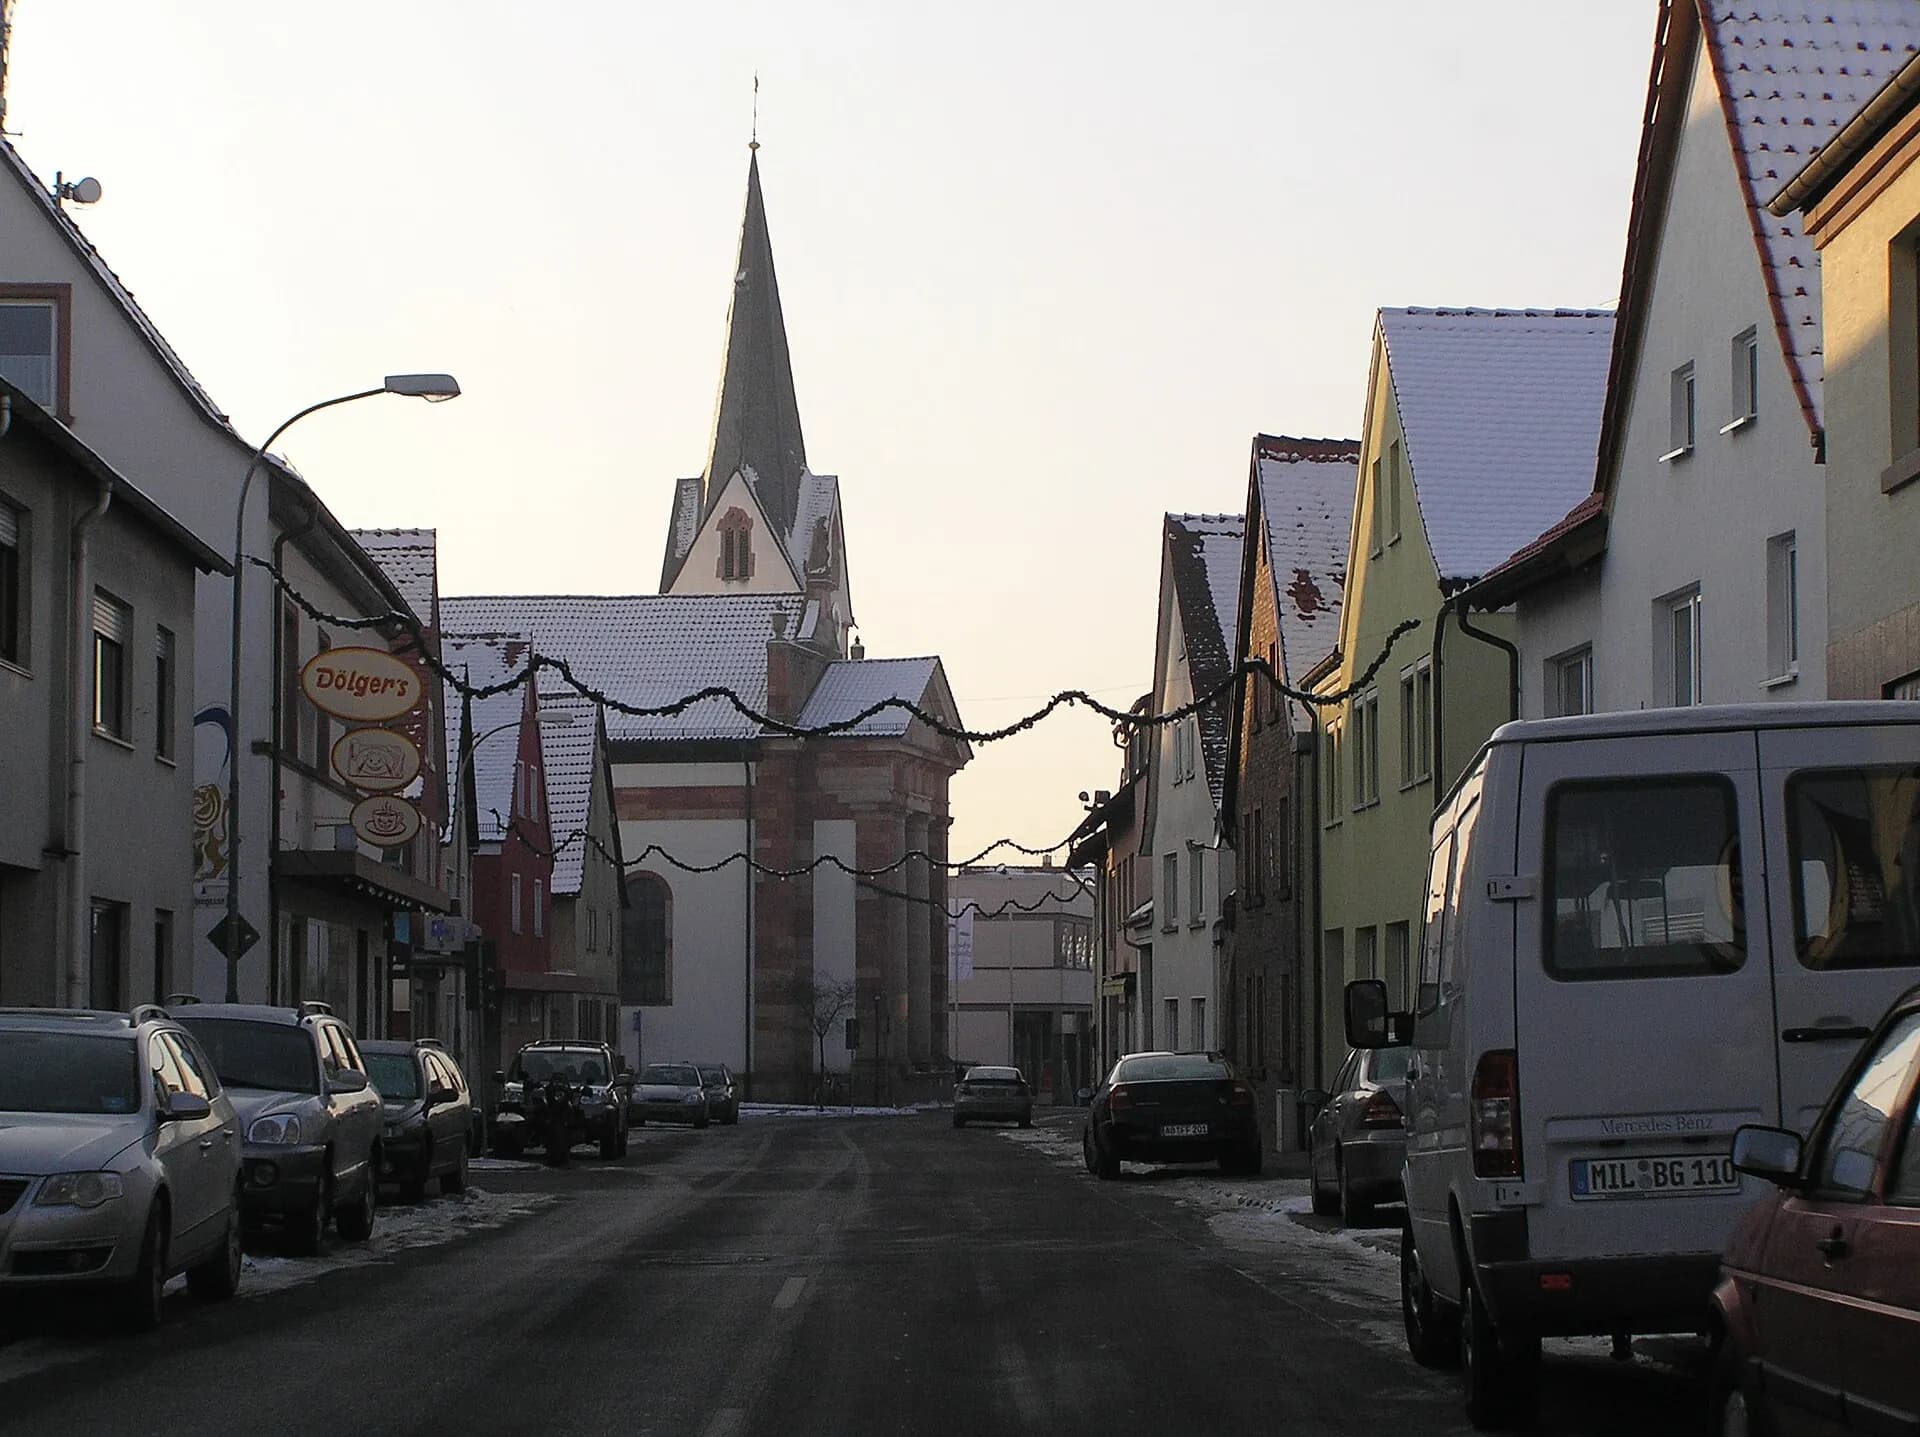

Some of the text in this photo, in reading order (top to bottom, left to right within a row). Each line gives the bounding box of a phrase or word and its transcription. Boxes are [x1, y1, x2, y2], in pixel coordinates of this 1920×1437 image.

[317, 668, 408, 697] Dölger's
[1601, 1115, 1712, 1135] Mercedes Benz
[1591, 1158, 1736, 1190] MIL BG 110
